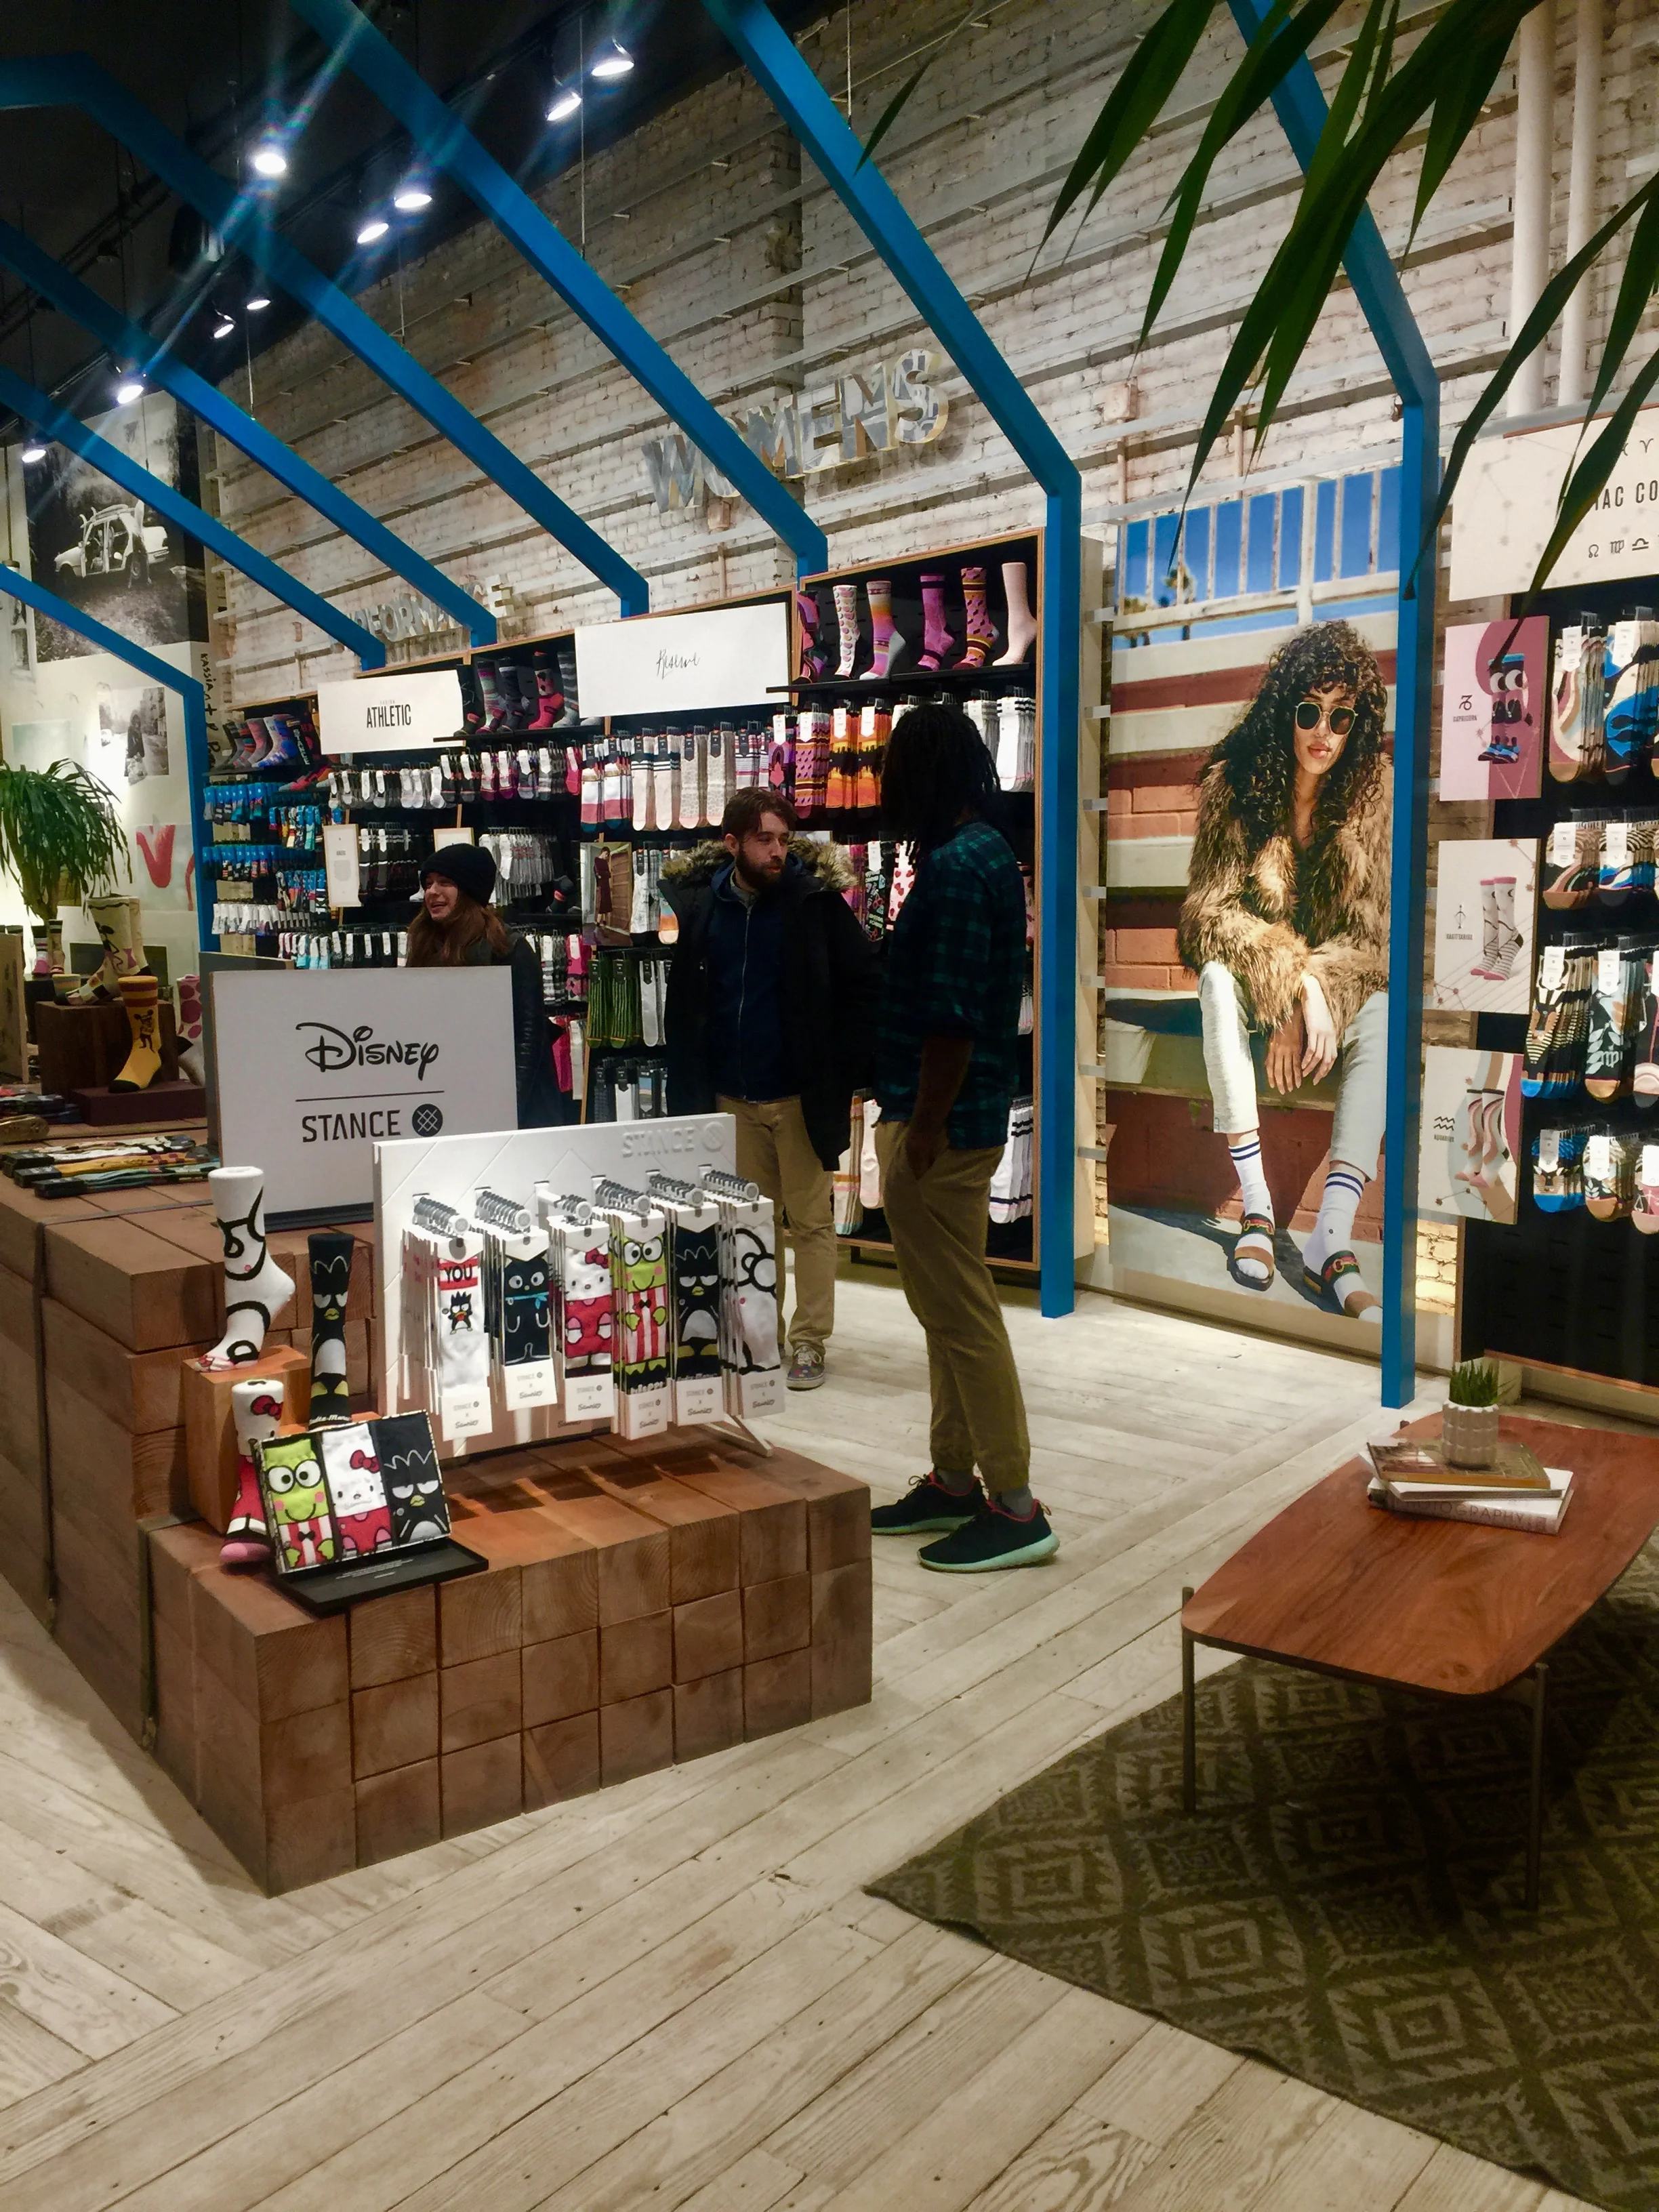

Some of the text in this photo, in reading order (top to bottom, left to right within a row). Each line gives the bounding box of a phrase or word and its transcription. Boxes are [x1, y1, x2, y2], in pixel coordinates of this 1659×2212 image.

[656, 649, 701, 680] Reserve
[366, 703, 411, 729] ATHLETIC
[295, 1022, 440, 1081] Disney
[302, 1109, 402, 1143] STANCE
[622, 1126, 696, 1158] STANCE
[443, 1263, 473, 1284] YOU
